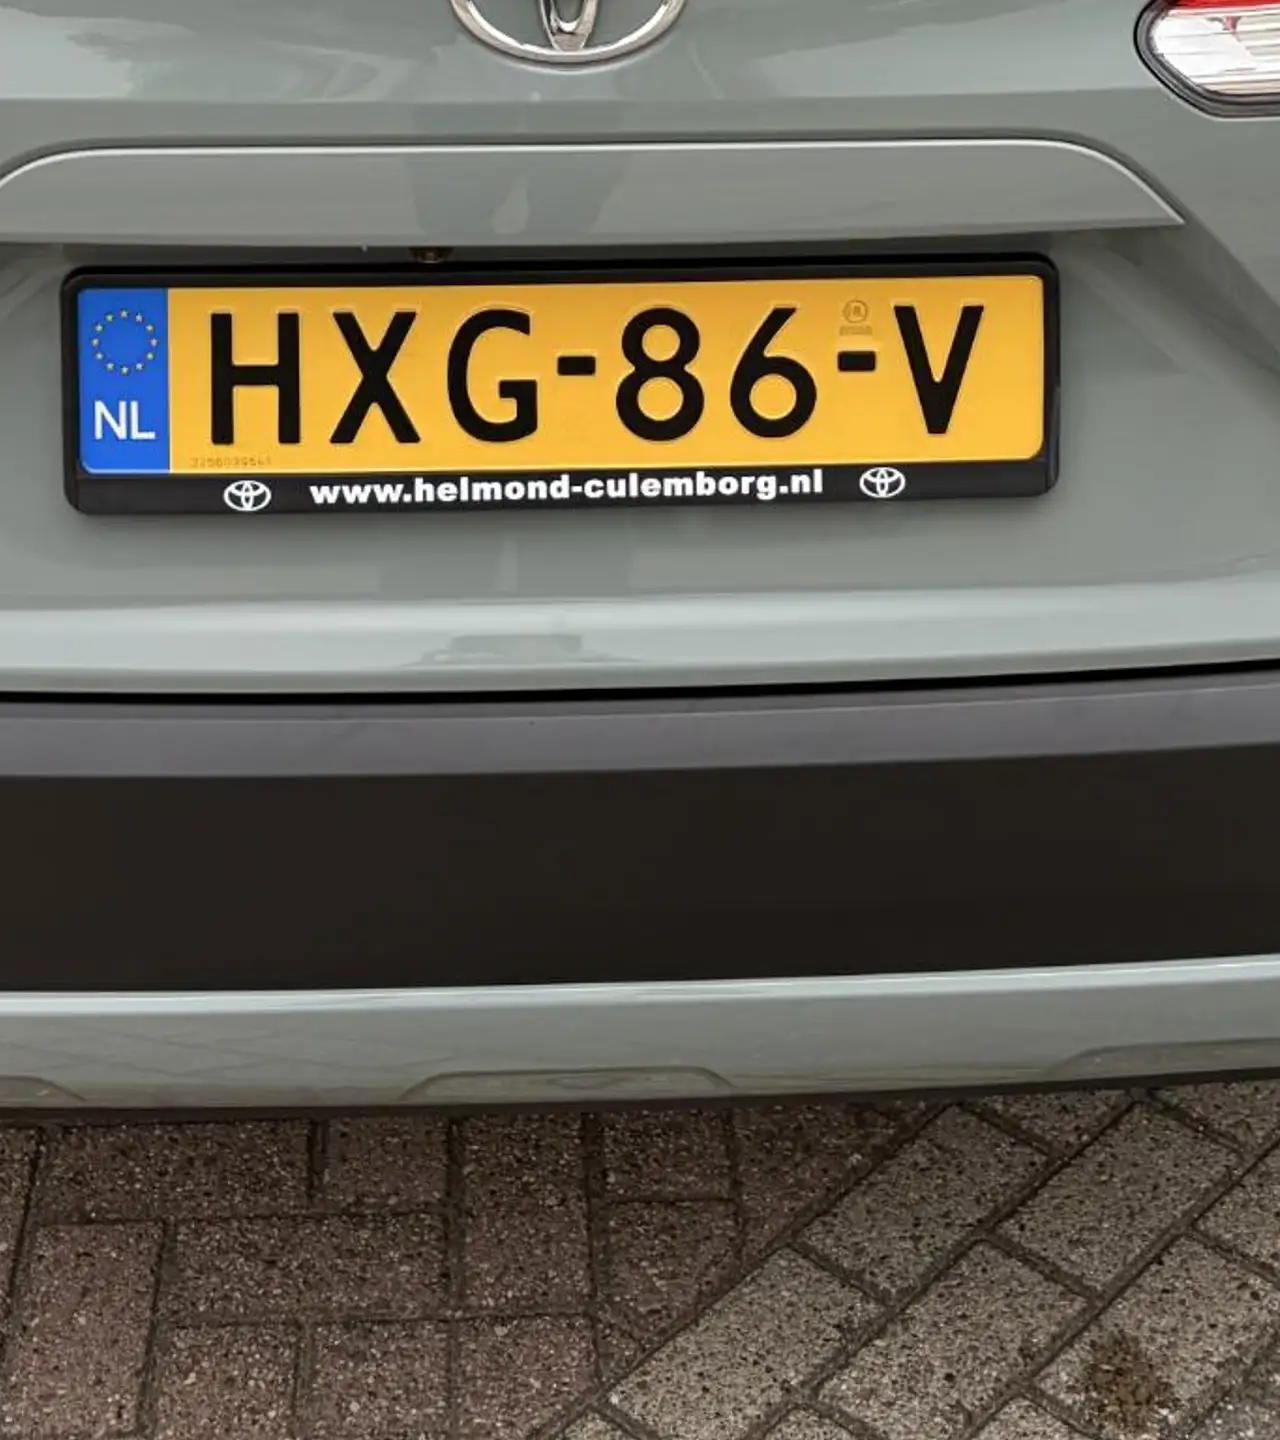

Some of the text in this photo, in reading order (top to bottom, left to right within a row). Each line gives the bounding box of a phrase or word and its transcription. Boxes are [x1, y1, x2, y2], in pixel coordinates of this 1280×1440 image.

[210, 305, 985, 445] HXG-86-V
[93, 400, 156, 440] NL
[309, 469, 824, 505] www.helmond-culemborg.nl
